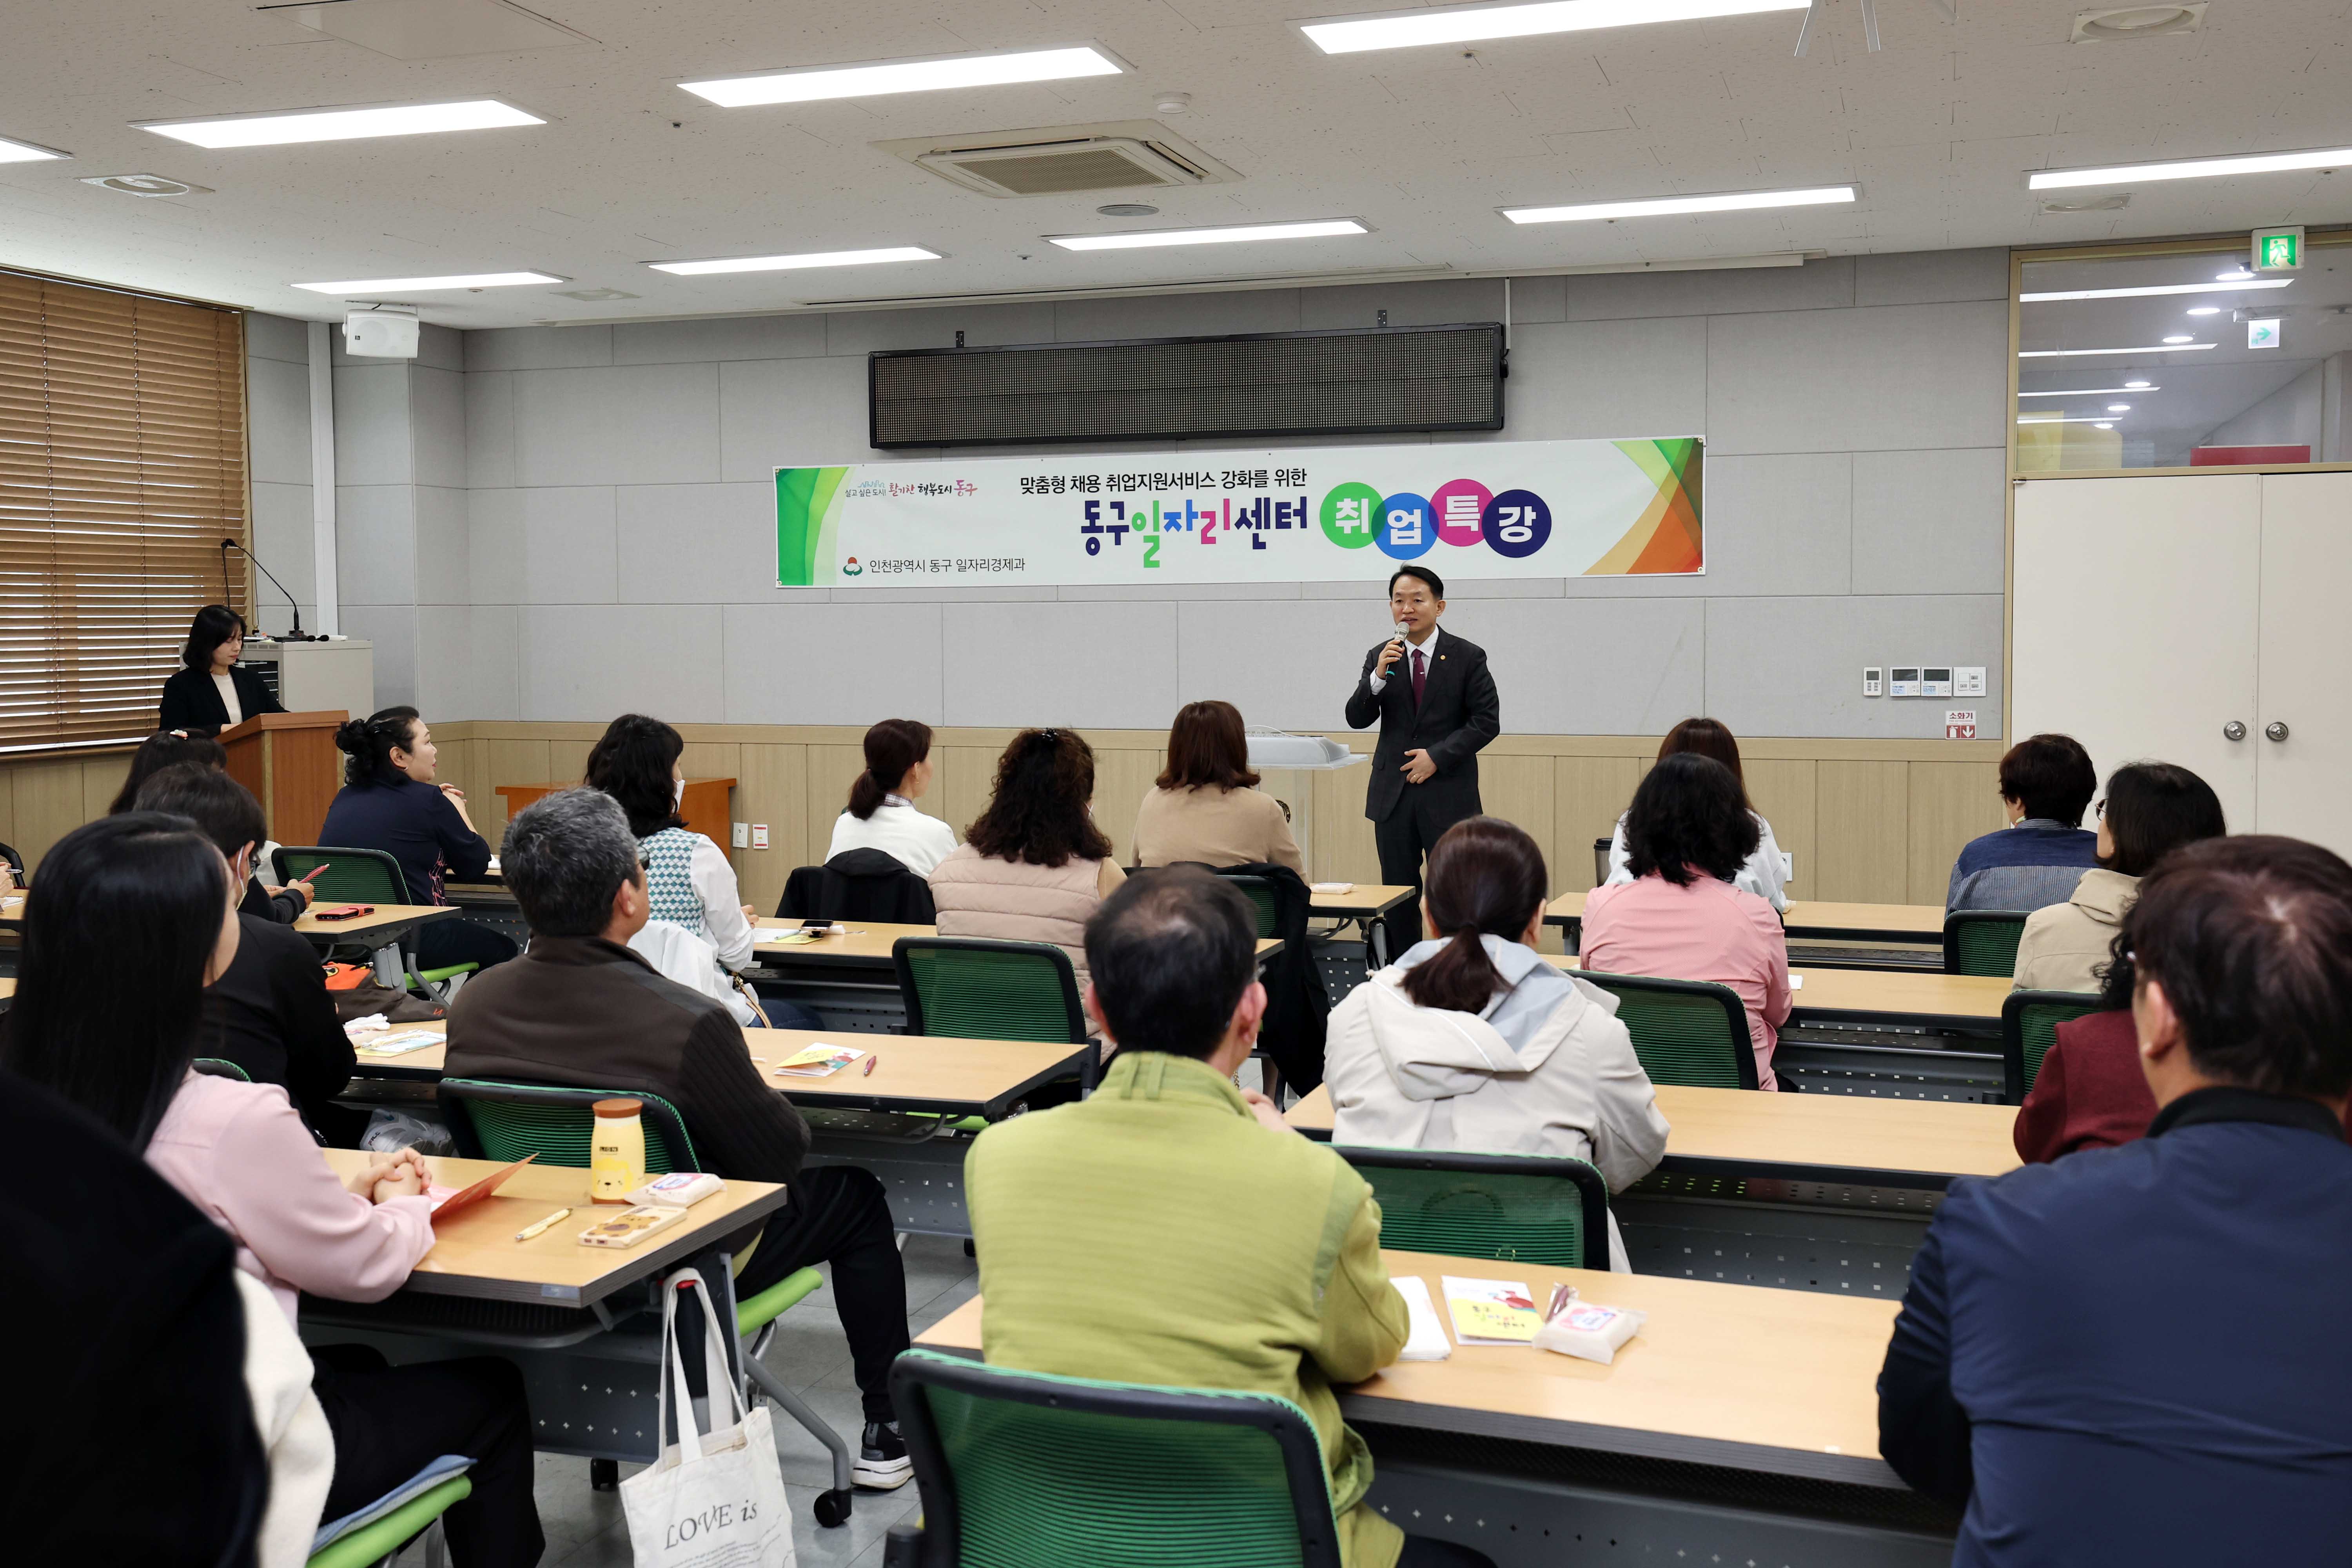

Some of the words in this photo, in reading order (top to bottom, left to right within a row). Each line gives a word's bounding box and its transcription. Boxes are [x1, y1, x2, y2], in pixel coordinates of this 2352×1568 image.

[889, 483, 915, 497] 활기찬
[918, 483, 952, 496] 행복도시
[954, 480, 978, 496] 동구
[1021, 476, 1065, 494] 맞춤형
[1070, 475, 1101, 493] 채용
[1106, 472, 1216, 492] 취업지원서비스
[1221, 470, 1269, 489] 강화를
[1274, 468, 1307, 487] 위한
[870, 560, 925, 573] 인천광역시
[929, 560, 952, 572] 동구
[956, 558, 1025, 572] 일자리경제과
[664, 1504, 732, 1550] LOVE
[740, 1500, 757, 1521] is
